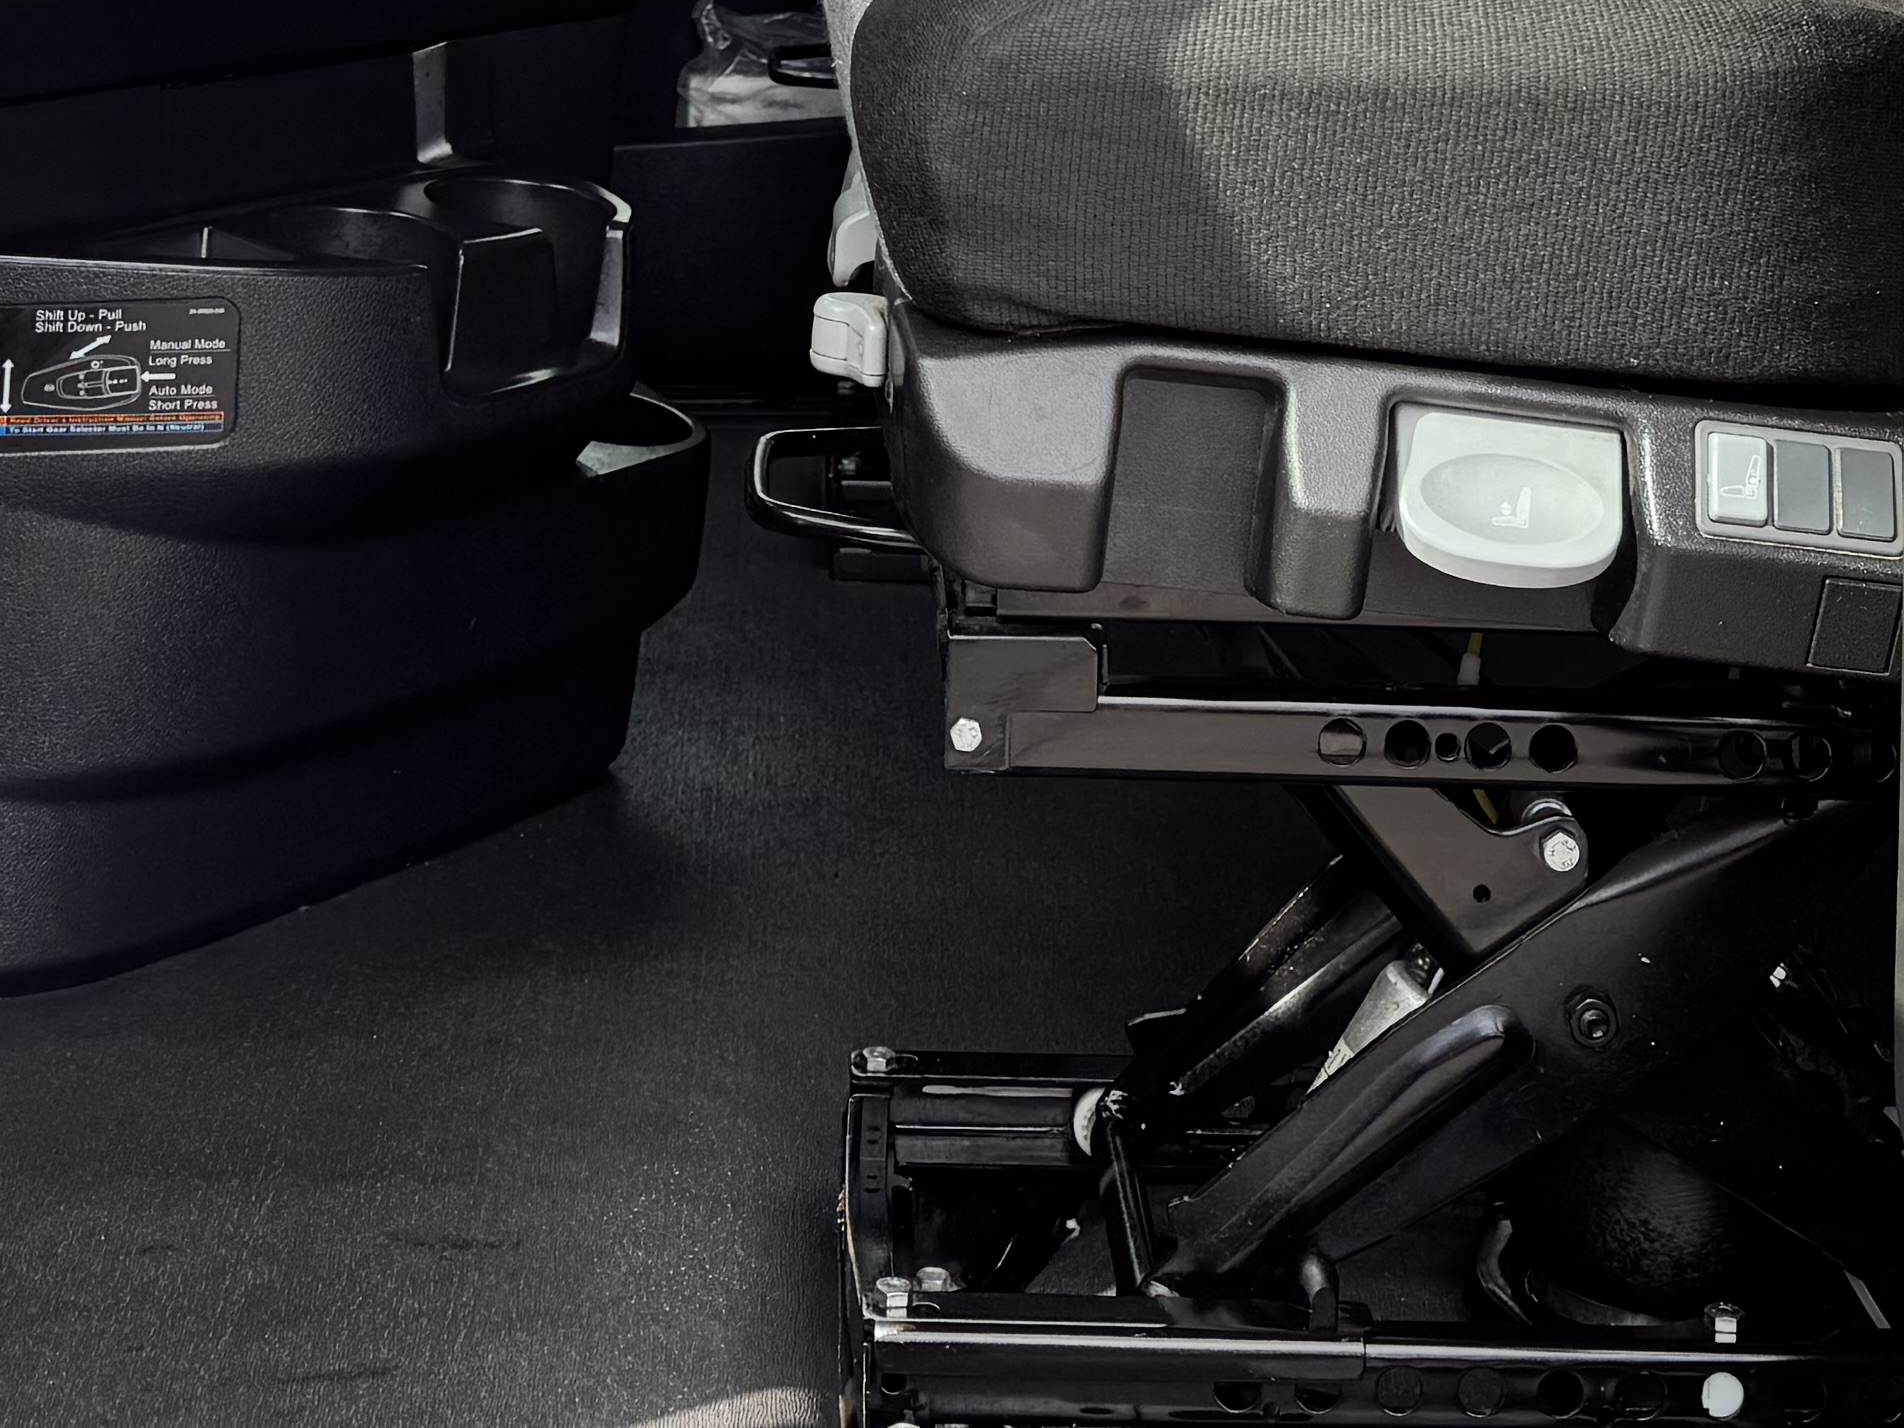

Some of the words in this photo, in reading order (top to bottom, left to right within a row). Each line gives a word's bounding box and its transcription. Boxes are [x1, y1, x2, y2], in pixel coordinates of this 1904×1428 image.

[36, 310, 64, 321] Shift
[68, 310, 85, 323] Up
[98, 309, 122, 320] Pull
[35, 322, 63, 333] Shift
[68, 321, 102, 332] Down
[114, 320, 146, 331] Push
[150, 340, 191, 350] Manual
[195, 339, 225, 349] Mode
[149, 356, 177, 367] Long
[181, 355, 212, 365] Press
[149, 386, 176, 395] Auto
[181, 384, 213, 394] Mode
[148, 400, 180, 411] Short
[184, 399, 218, 410] Press
